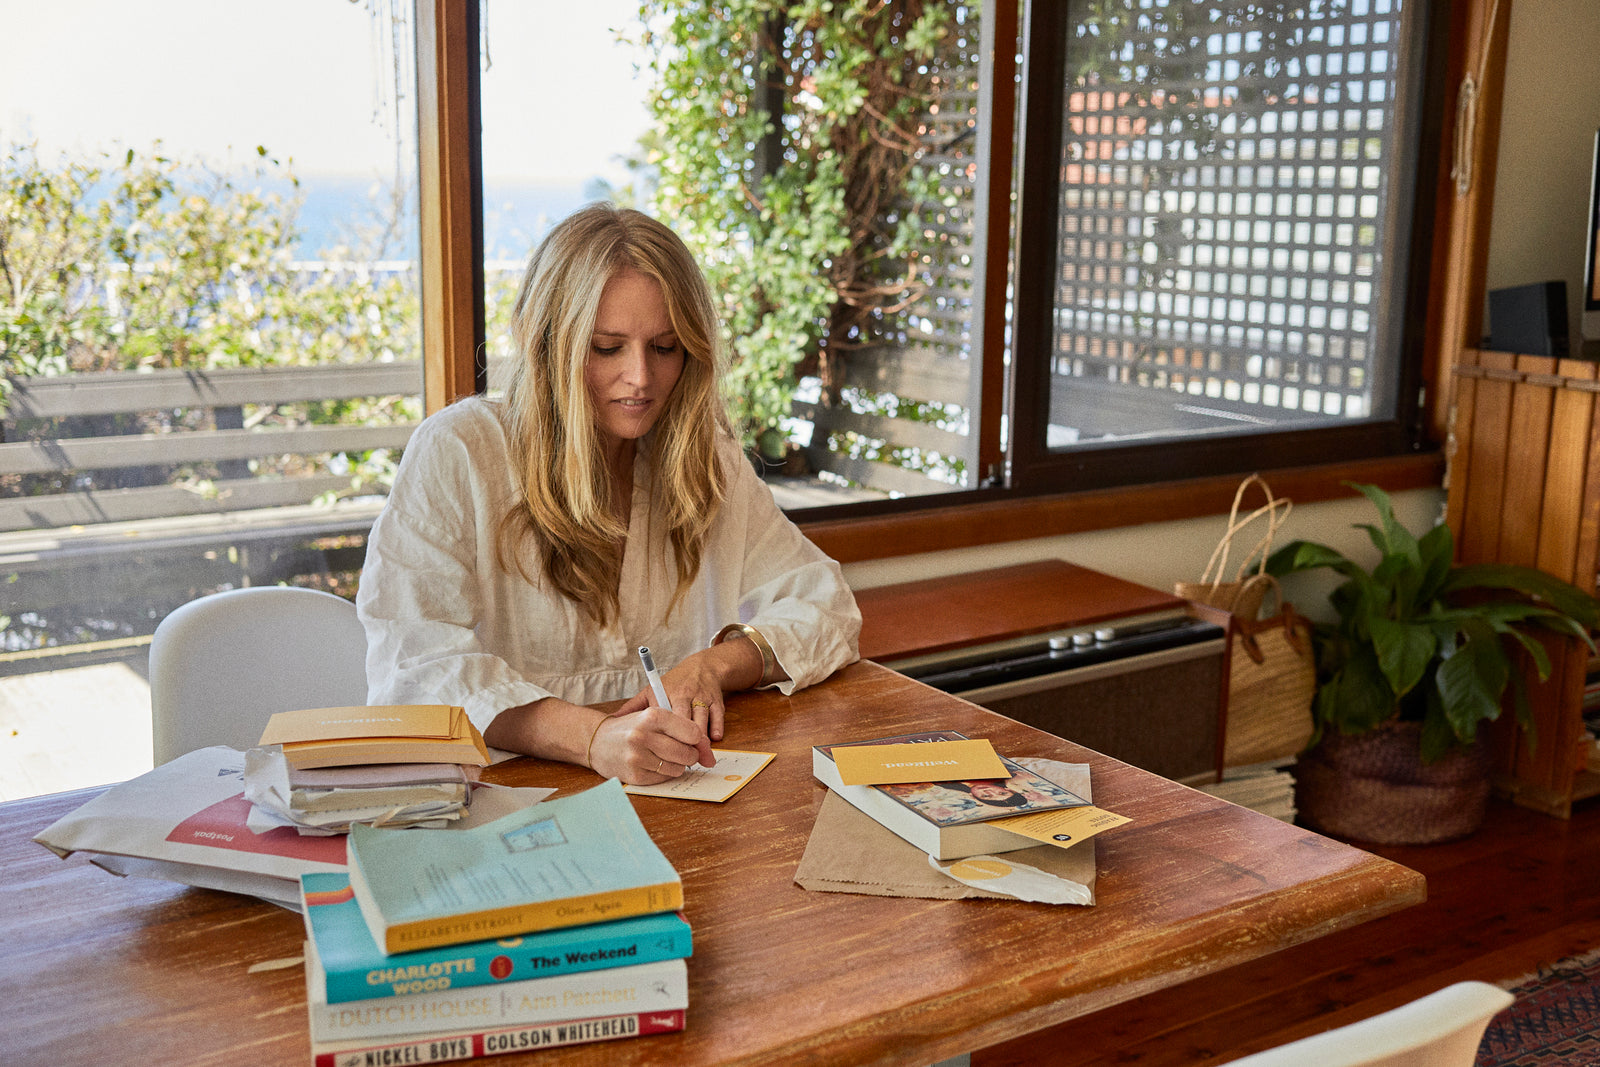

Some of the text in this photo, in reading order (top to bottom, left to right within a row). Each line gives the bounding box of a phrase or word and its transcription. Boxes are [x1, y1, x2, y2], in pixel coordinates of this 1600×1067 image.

[881, 760, 959, 769] WellRead.
[193, 831, 235, 842] Postpak
[593, 901, 623, 914] Again
[400, 914, 522, 941] ELIZABETH STROUT
[530, 944, 637, 970] The Weekend
[366, 958, 475, 985] CHARLOTTE
[392, 976, 451, 996] WOOD
[519, 994, 557, 1012] Ann
[563, 987, 636, 1007] Patchett
[340, 1003, 415, 1028] DUTCH
[421, 998, 492, 1020] HOUSE
[487, 1018, 636, 1051] COLSON WHITEHEAD
[365, 1045, 422, 1067] NICKEL
[429, 1039, 468, 1061] BOYS
